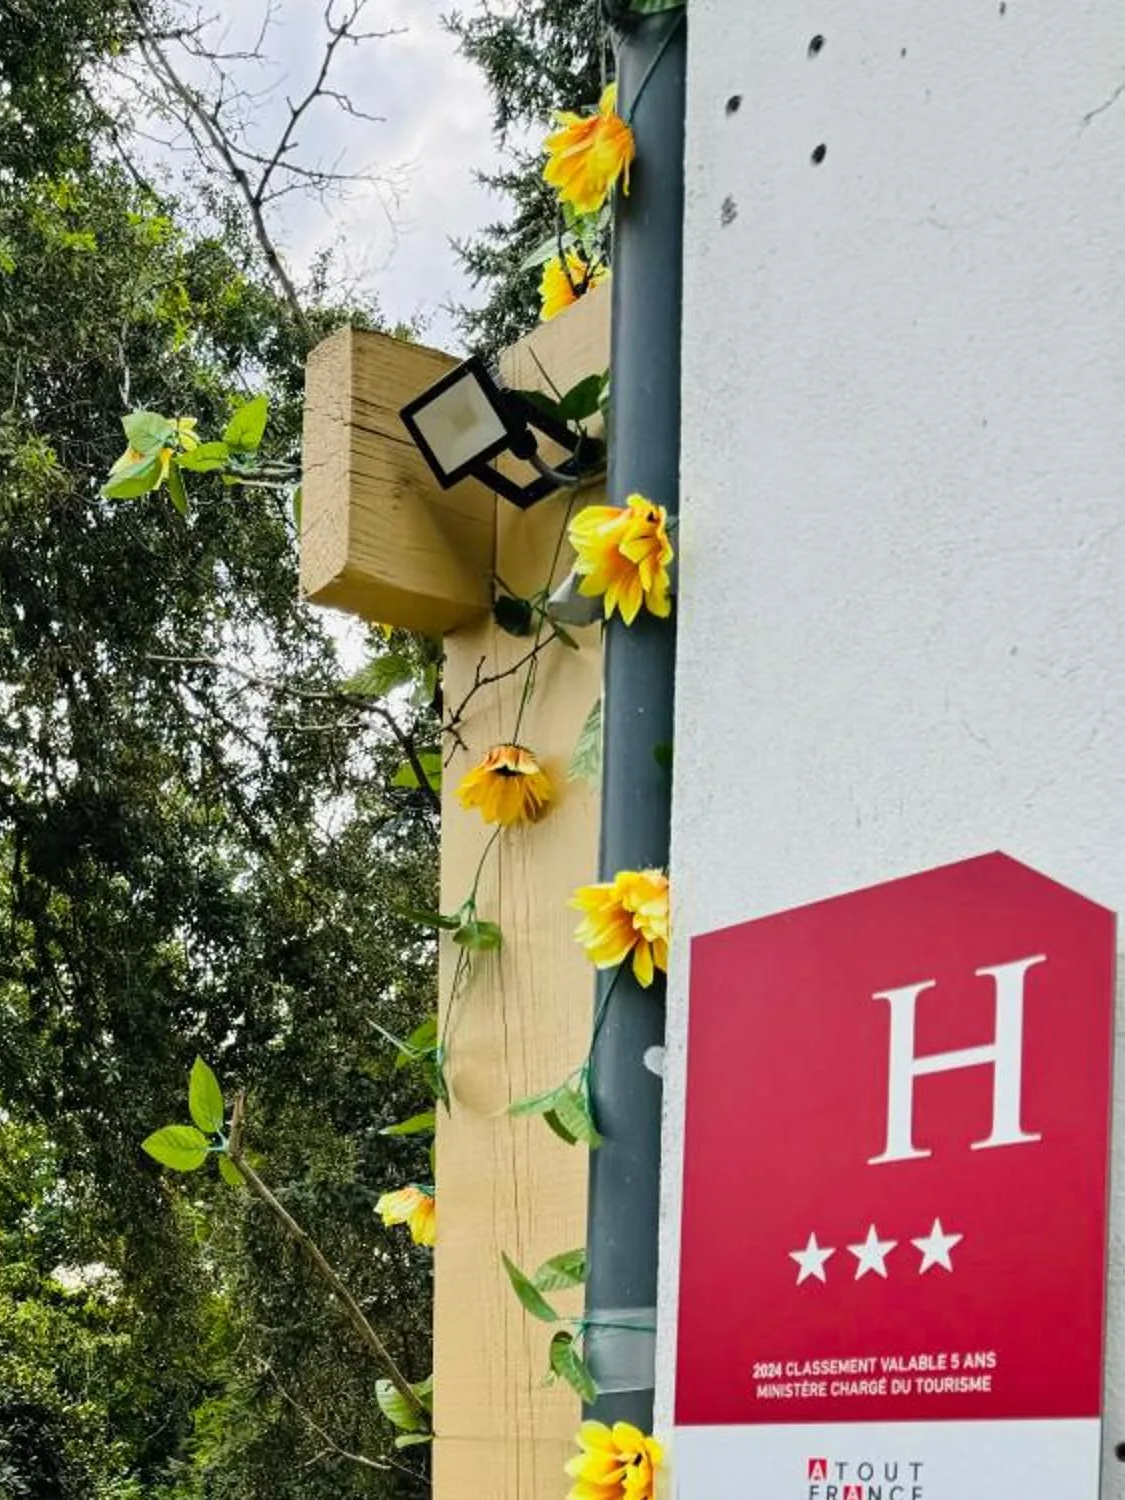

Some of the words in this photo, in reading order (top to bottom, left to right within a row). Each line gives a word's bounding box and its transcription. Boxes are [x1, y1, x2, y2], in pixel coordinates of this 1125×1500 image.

[867, 953, 1047, 1165] H
[753, 1361, 782, 1379] 2024
[785, 1357, 876, 1377] CLASSEMENT
[880, 1353, 947, 1373] VALABLE
[950, 1352, 960, 1370] 5
[962, 1351, 997, 1369] ANS
[756, 1380, 828, 1399] MINISTÈRE
[830, 1377, 887, 1397] CHARGÉ
[890, 1378, 912, 1395] DU
[915, 1375, 992, 1394] TOURISME
[808, 1459, 923, 1481] ATOUT
